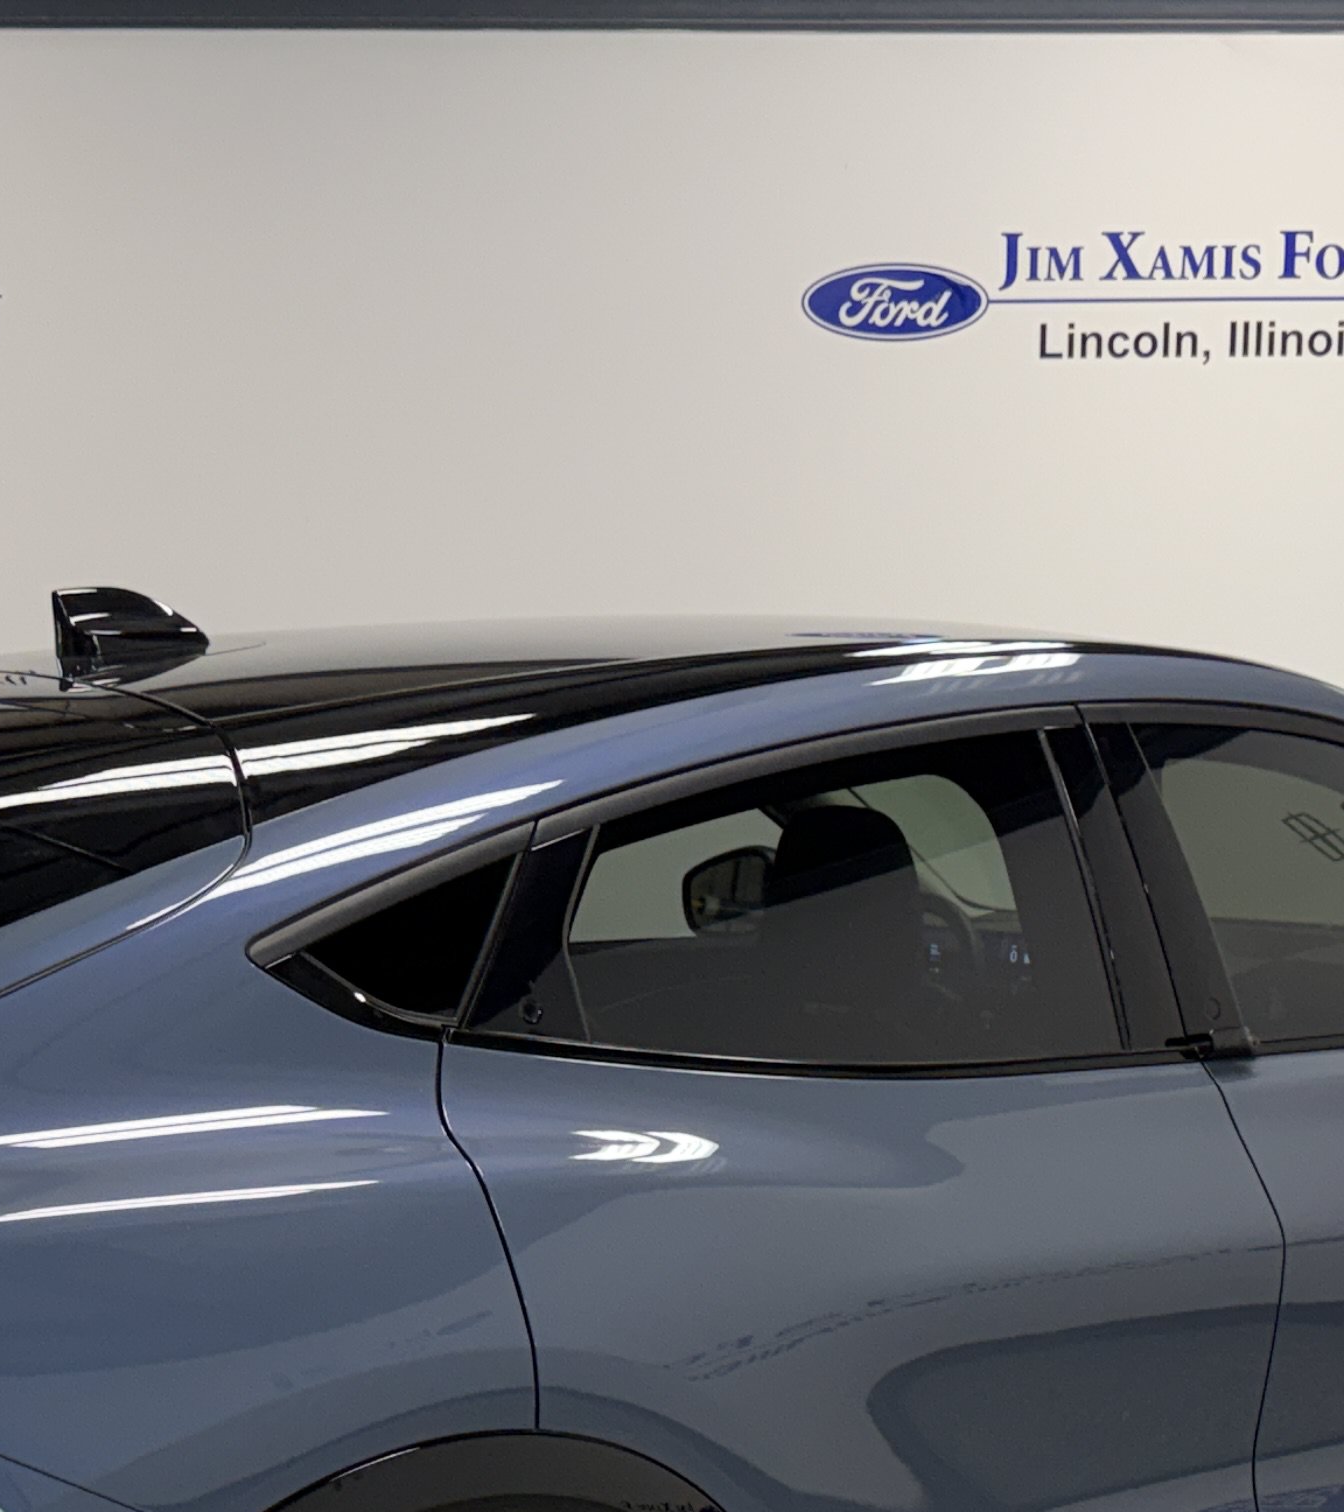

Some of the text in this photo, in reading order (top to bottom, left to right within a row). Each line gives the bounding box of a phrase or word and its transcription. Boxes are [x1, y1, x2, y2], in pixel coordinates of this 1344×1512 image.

[998, 233, 1084, 291] JIM
[1099, 232, 1261, 280] XAMIS
[1039, 322, 1210, 365] Lincoln,
